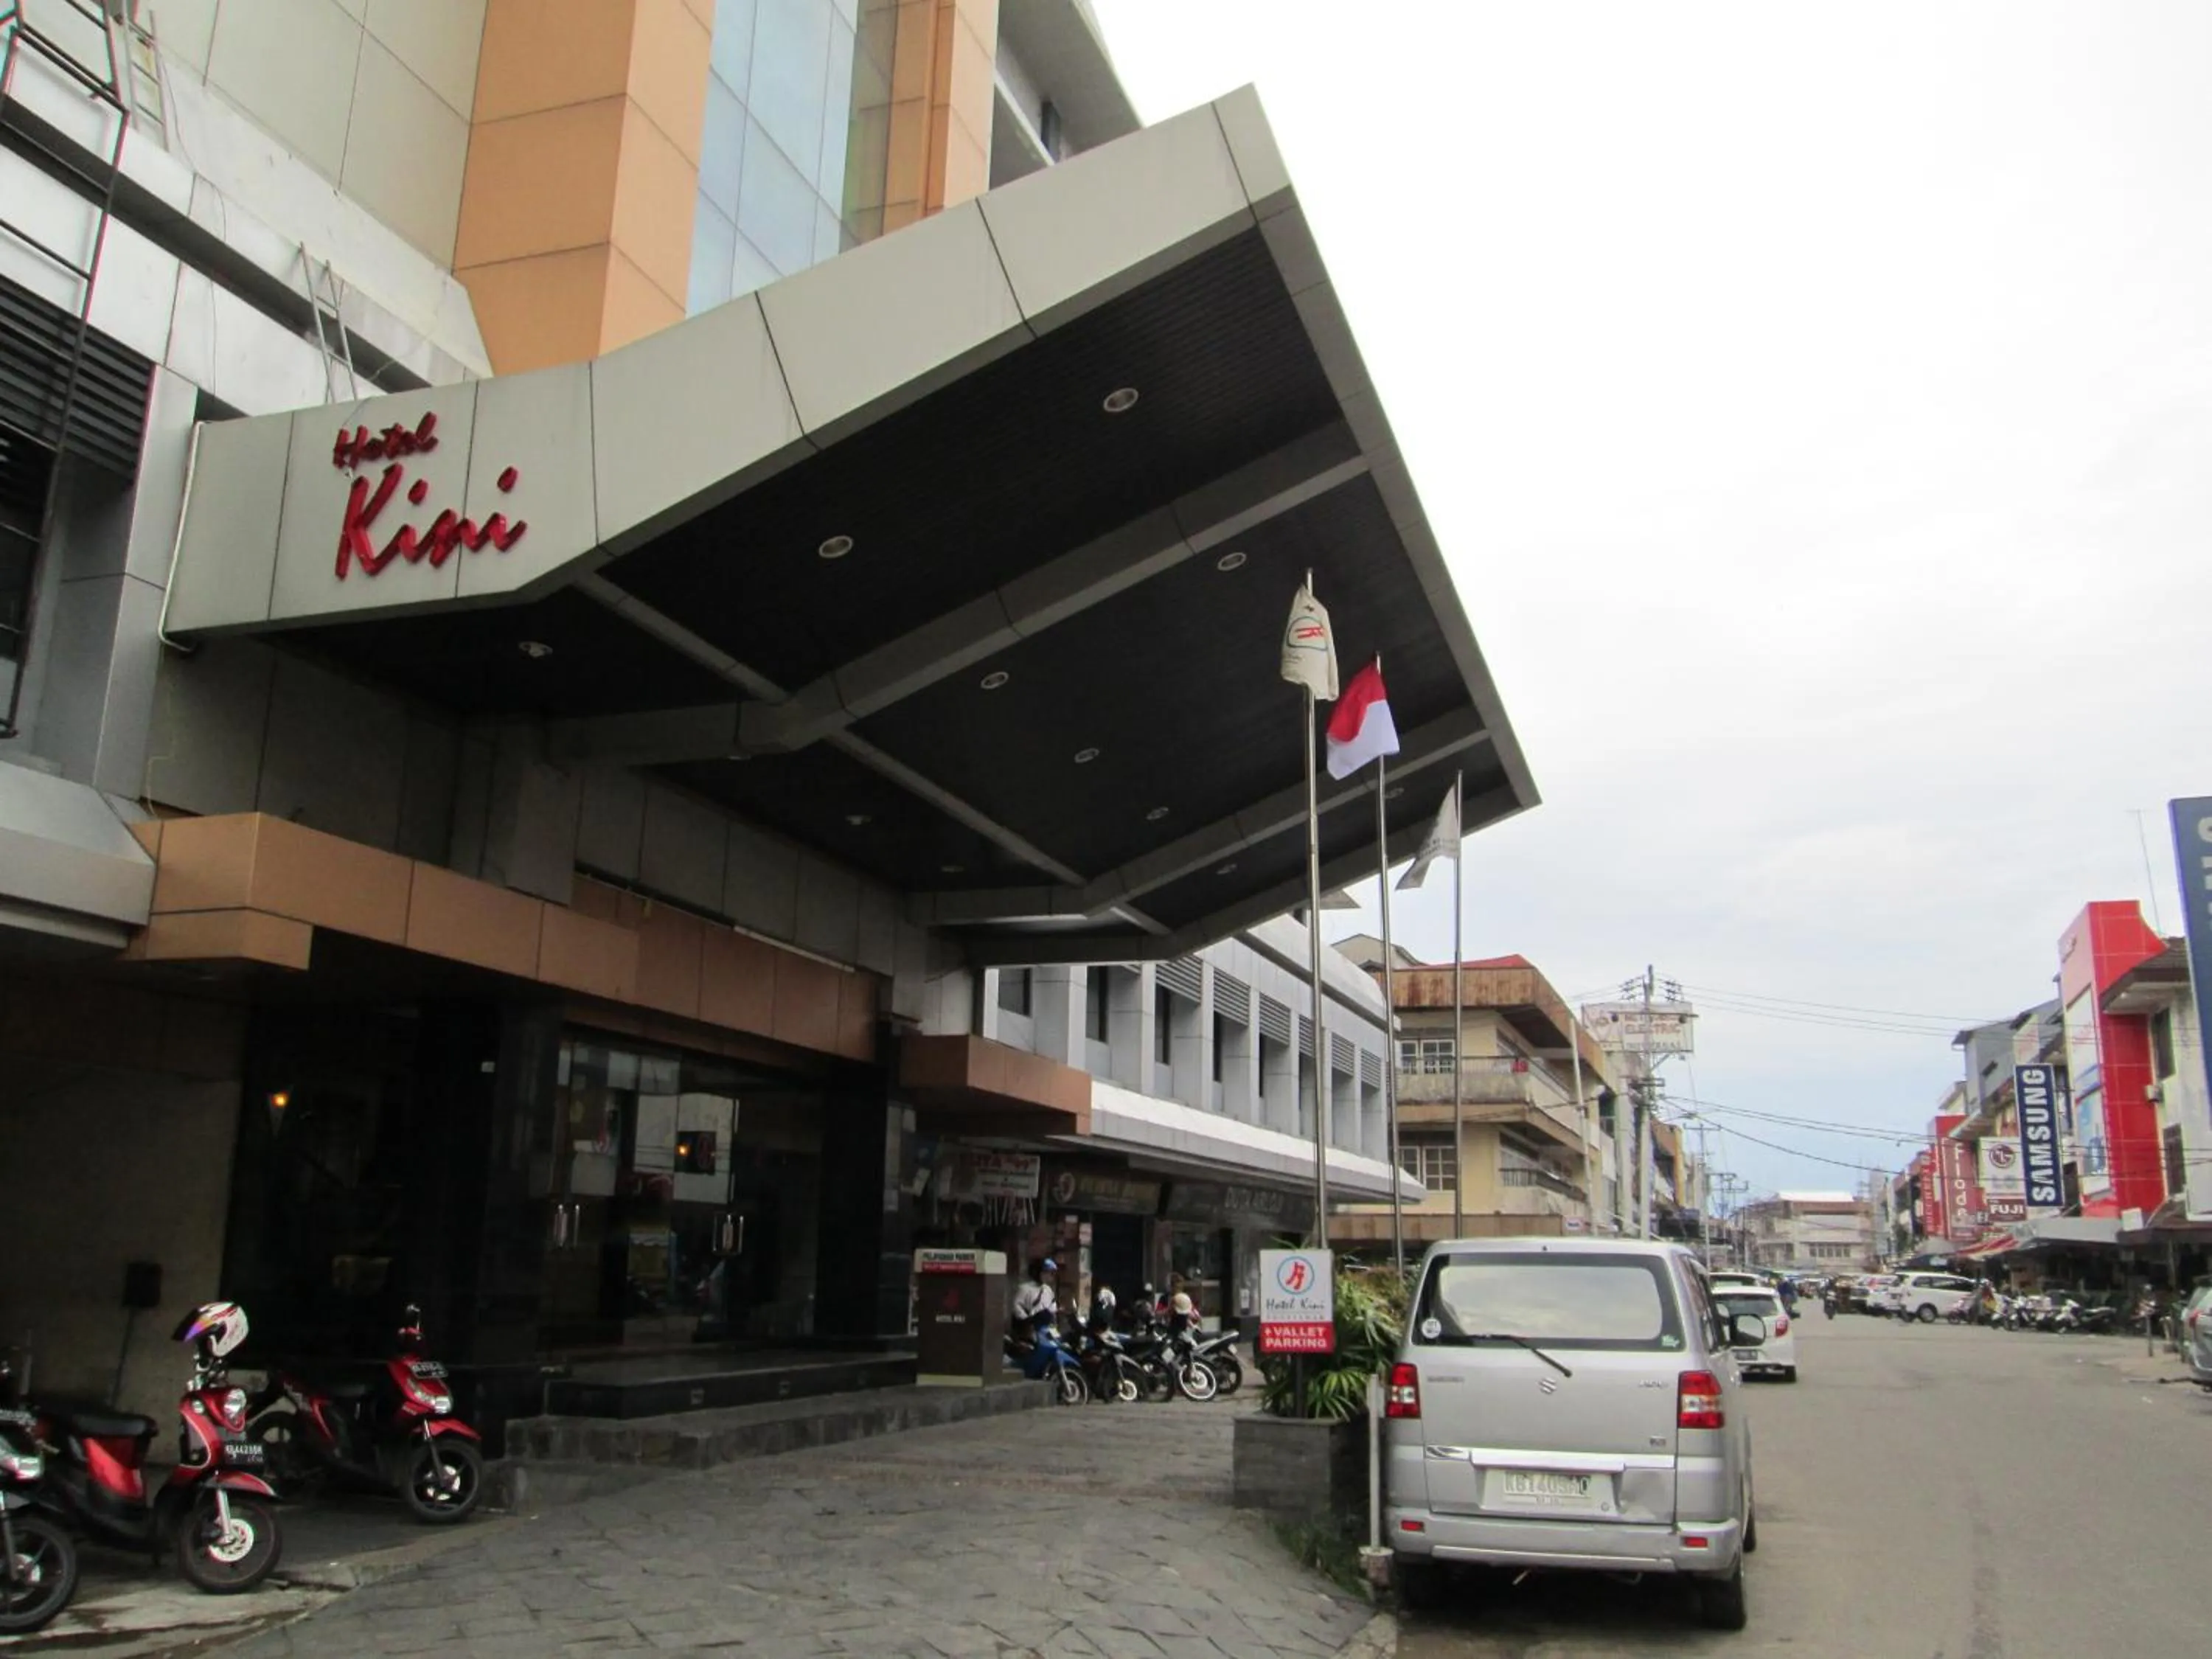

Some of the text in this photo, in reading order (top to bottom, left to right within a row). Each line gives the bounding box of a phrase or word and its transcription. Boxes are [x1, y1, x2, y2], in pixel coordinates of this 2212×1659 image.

[333, 411, 439, 470] Hotel
[334, 462, 528, 582] Kini
[2022, 1069, 2056, 1203] SAMSUNG
[1990, 1203, 2025, 1214] FUJI
[1265, 1338, 1326, 1348] PARKING
[1273, 1326, 1325, 1337] VALLET
